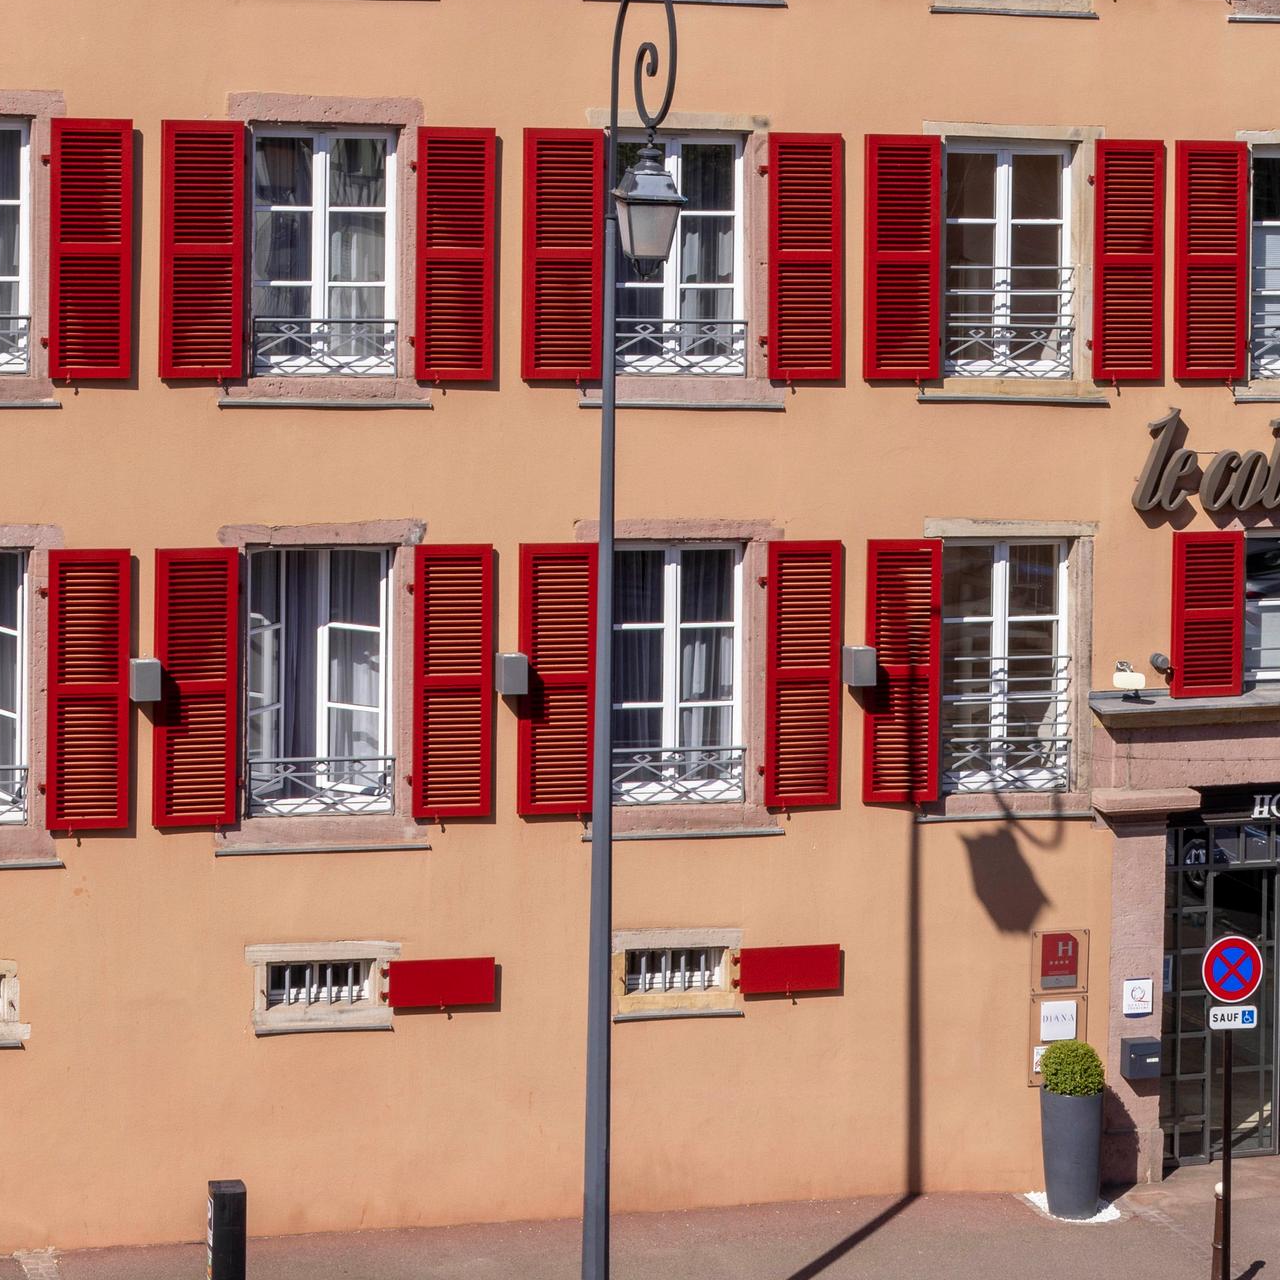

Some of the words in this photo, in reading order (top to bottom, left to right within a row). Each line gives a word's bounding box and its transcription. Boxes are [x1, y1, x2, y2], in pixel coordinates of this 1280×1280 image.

[1131, 406, 1199, 510] le
[1057, 941, 1073, 957] H
[1042, 1014, 1075, 1024] DIANA
[1212, 1013, 1239, 1023] SAUF
